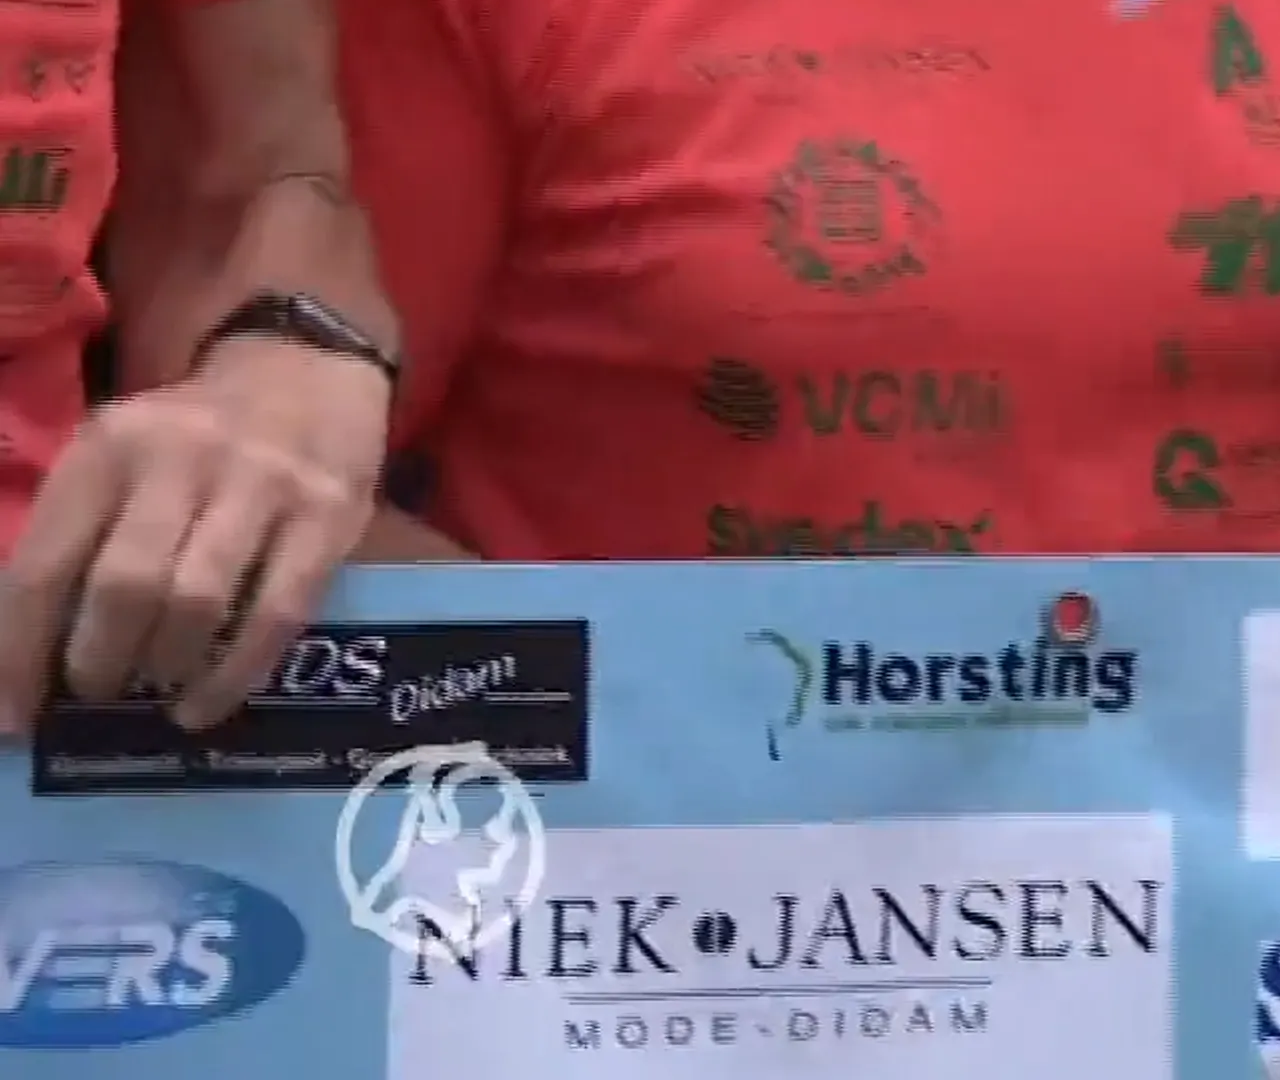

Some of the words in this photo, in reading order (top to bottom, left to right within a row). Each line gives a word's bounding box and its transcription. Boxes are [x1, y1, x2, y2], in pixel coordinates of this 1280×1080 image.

[822, 640, 1139, 712] Horsting
[408, 894, 682, 986] NIEK
[746, 877, 1166, 971] JANSEN
